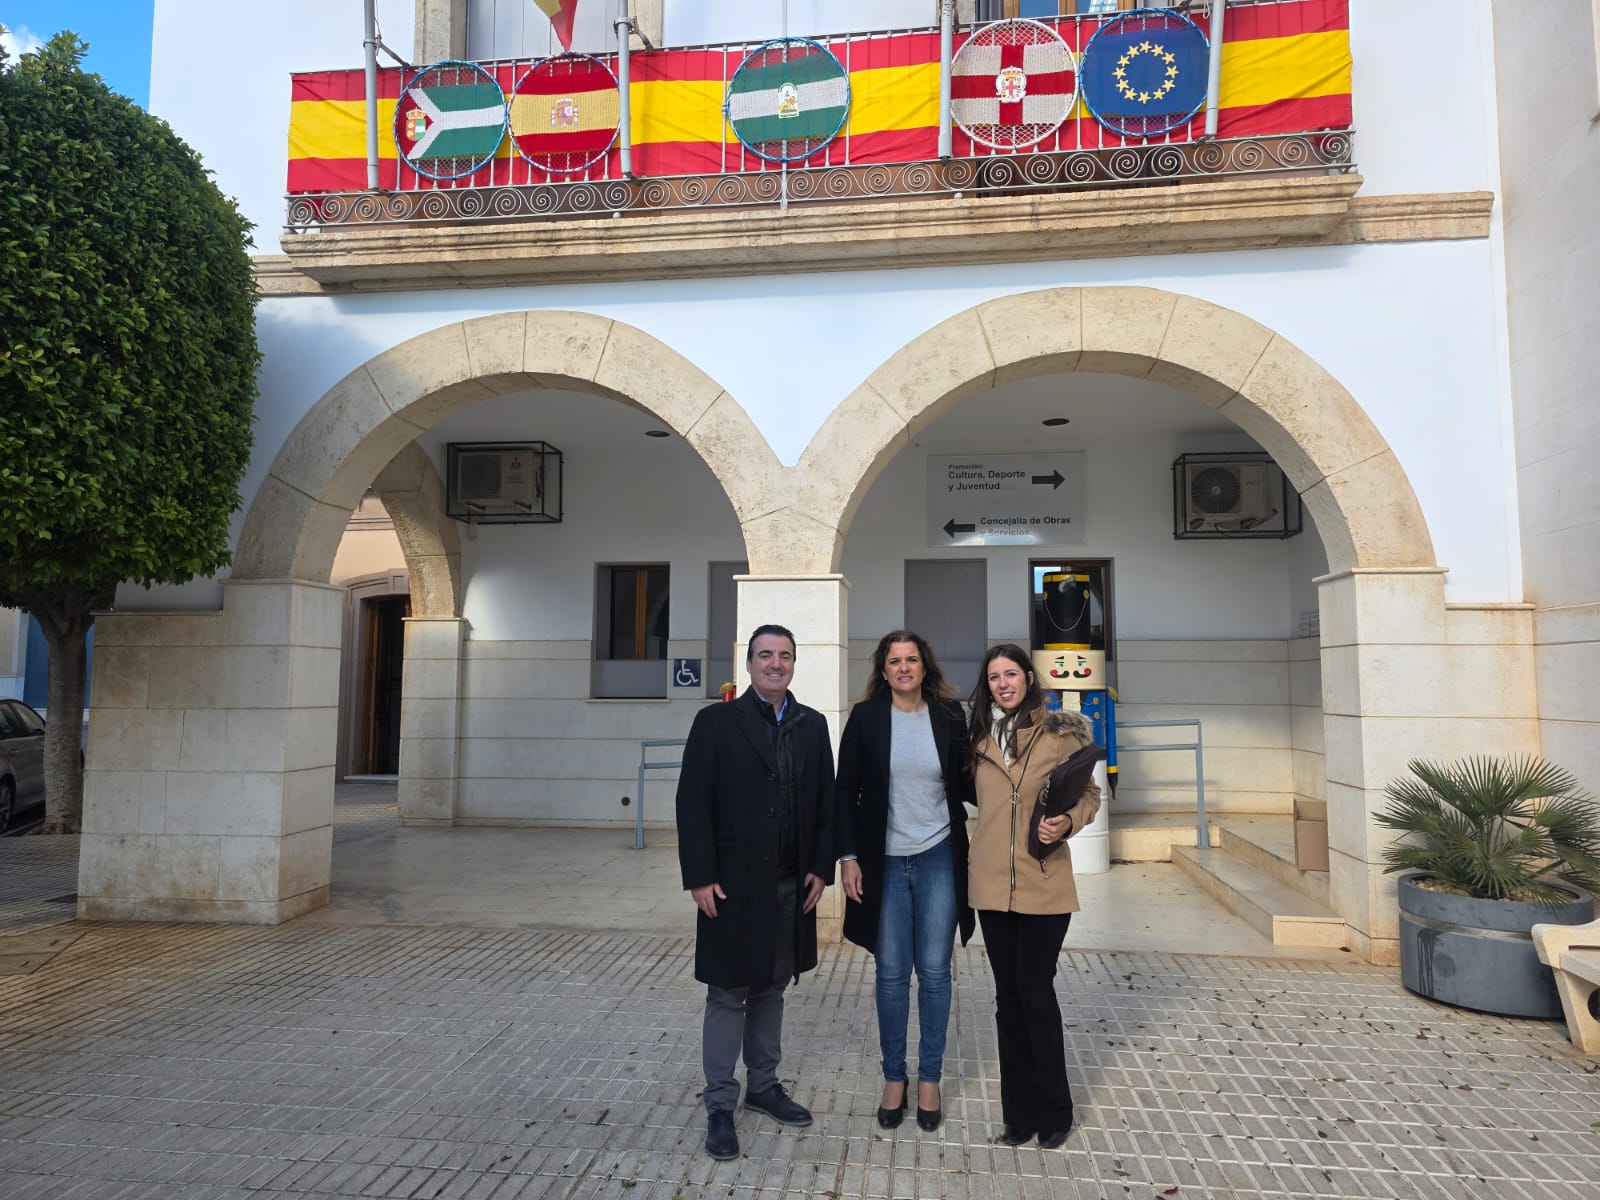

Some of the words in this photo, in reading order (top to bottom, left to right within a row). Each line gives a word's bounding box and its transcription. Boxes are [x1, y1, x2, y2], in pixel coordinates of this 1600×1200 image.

[949, 471, 985, 480] Cultura,
[988, 470, 1026, 480] Deporte
[949, 484, 954, 492] y
[956, 482, 1000, 491] Juventud
[1029, 517, 1041, 525] de
[1043, 516, 1071, 525] Obras
